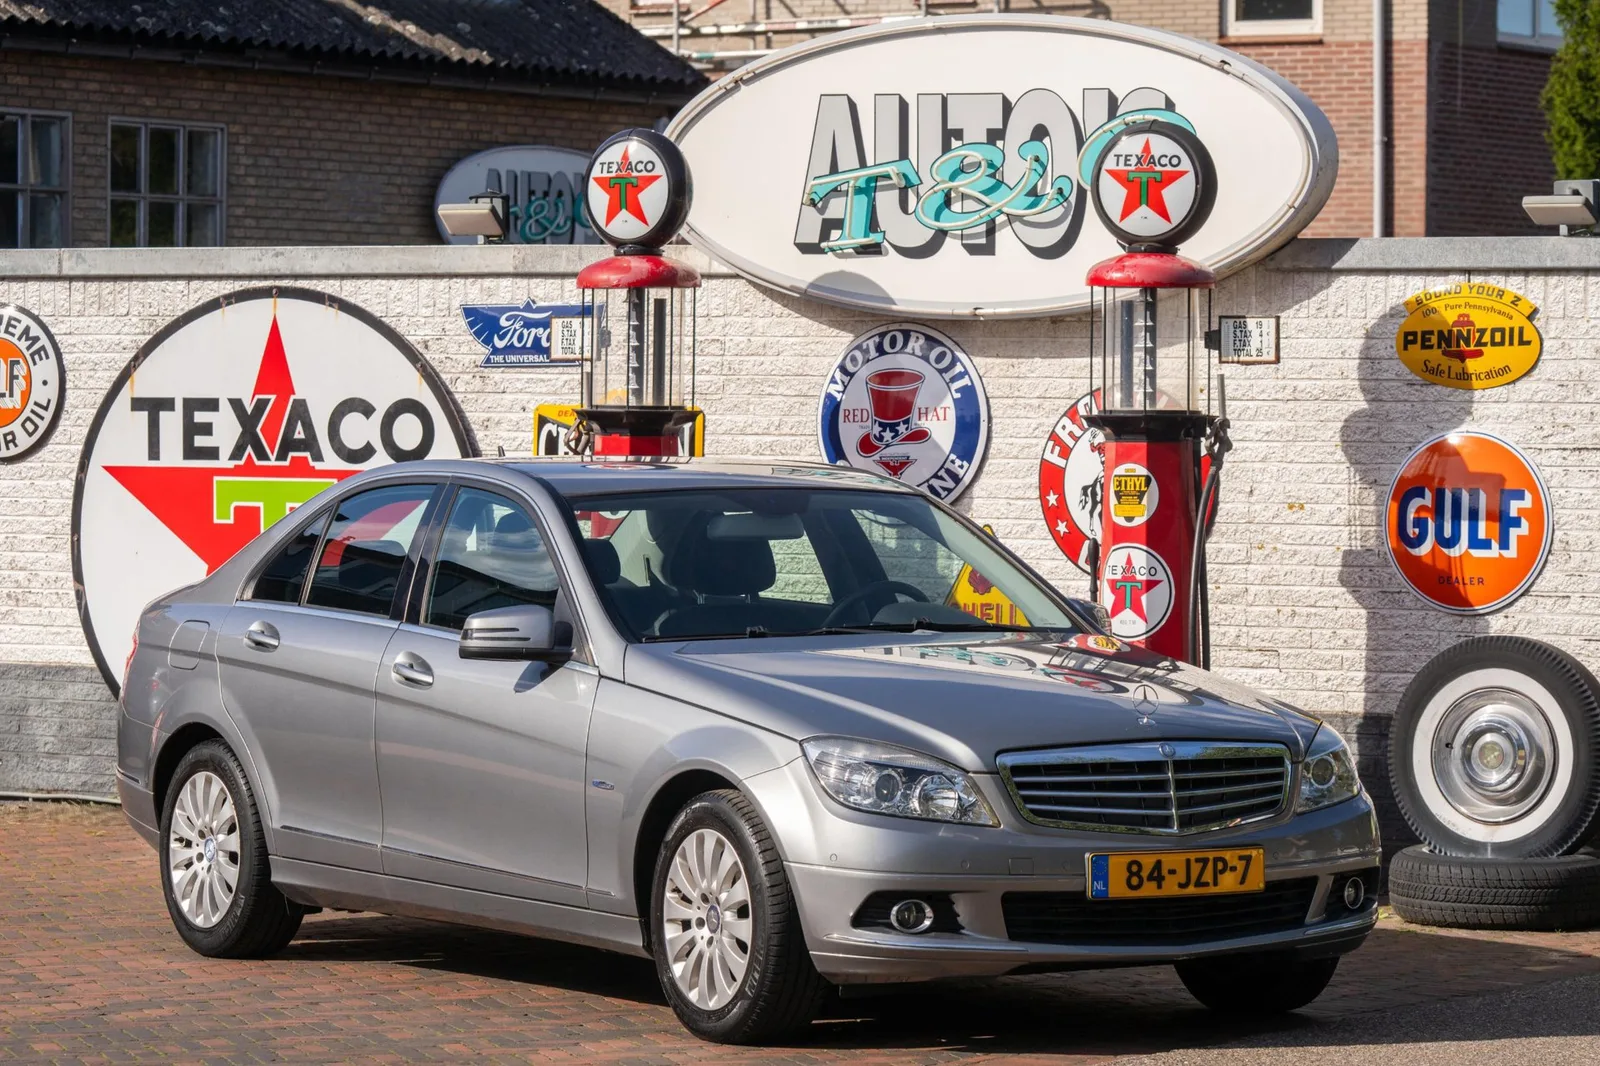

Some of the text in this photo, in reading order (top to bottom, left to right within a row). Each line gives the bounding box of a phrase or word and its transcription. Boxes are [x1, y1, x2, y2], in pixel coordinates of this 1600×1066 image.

[599, 160, 656, 174] TEXACO
[1113, 154, 1182, 168] TEXACO
[793, 86, 1177, 260] AUTO'
[609, 177, 638, 210] T
[1127, 171, 1162, 207] T
[1416, 284, 1522, 307] SOUND YOUR Z
[1444, 302, 1463, 311] Pure
[1463, 302, 1514, 321] Pennsylvania
[561, 320, 573, 329] GAS
[1232, 320, 1263, 330] GAS 19
[561, 329, 577, 338] S.TAX
[1232, 329, 1263, 339] S.TAX 4
[1403, 326, 1532, 351] PENNZOIL
[561, 338, 576, 347] F.TAX
[1232, 339, 1263, 348] F.TAX 1
[561, 346, 576, 355] TOTAL
[1232, 348, 1263, 357] TOTAL 25
[489, 354, 549, 363] THE UNIVERSAL
[826, 331, 972, 402] MOTOR OIL
[1421, 359, 1512, 381] Safe Lubrication
[20, 398, 51, 438] OIL
[843, 406, 950, 424] RED HAT
[131, 396, 436, 464] TEXACO
[1113, 476, 1148, 491] ETHYL
[1398, 486, 1532, 558] GULF
[1108, 565, 1158, 577] TEXACO
[1438, 575, 1485, 586] DEALER
[1093, 854, 1253, 892] NL 84-JZP-7
